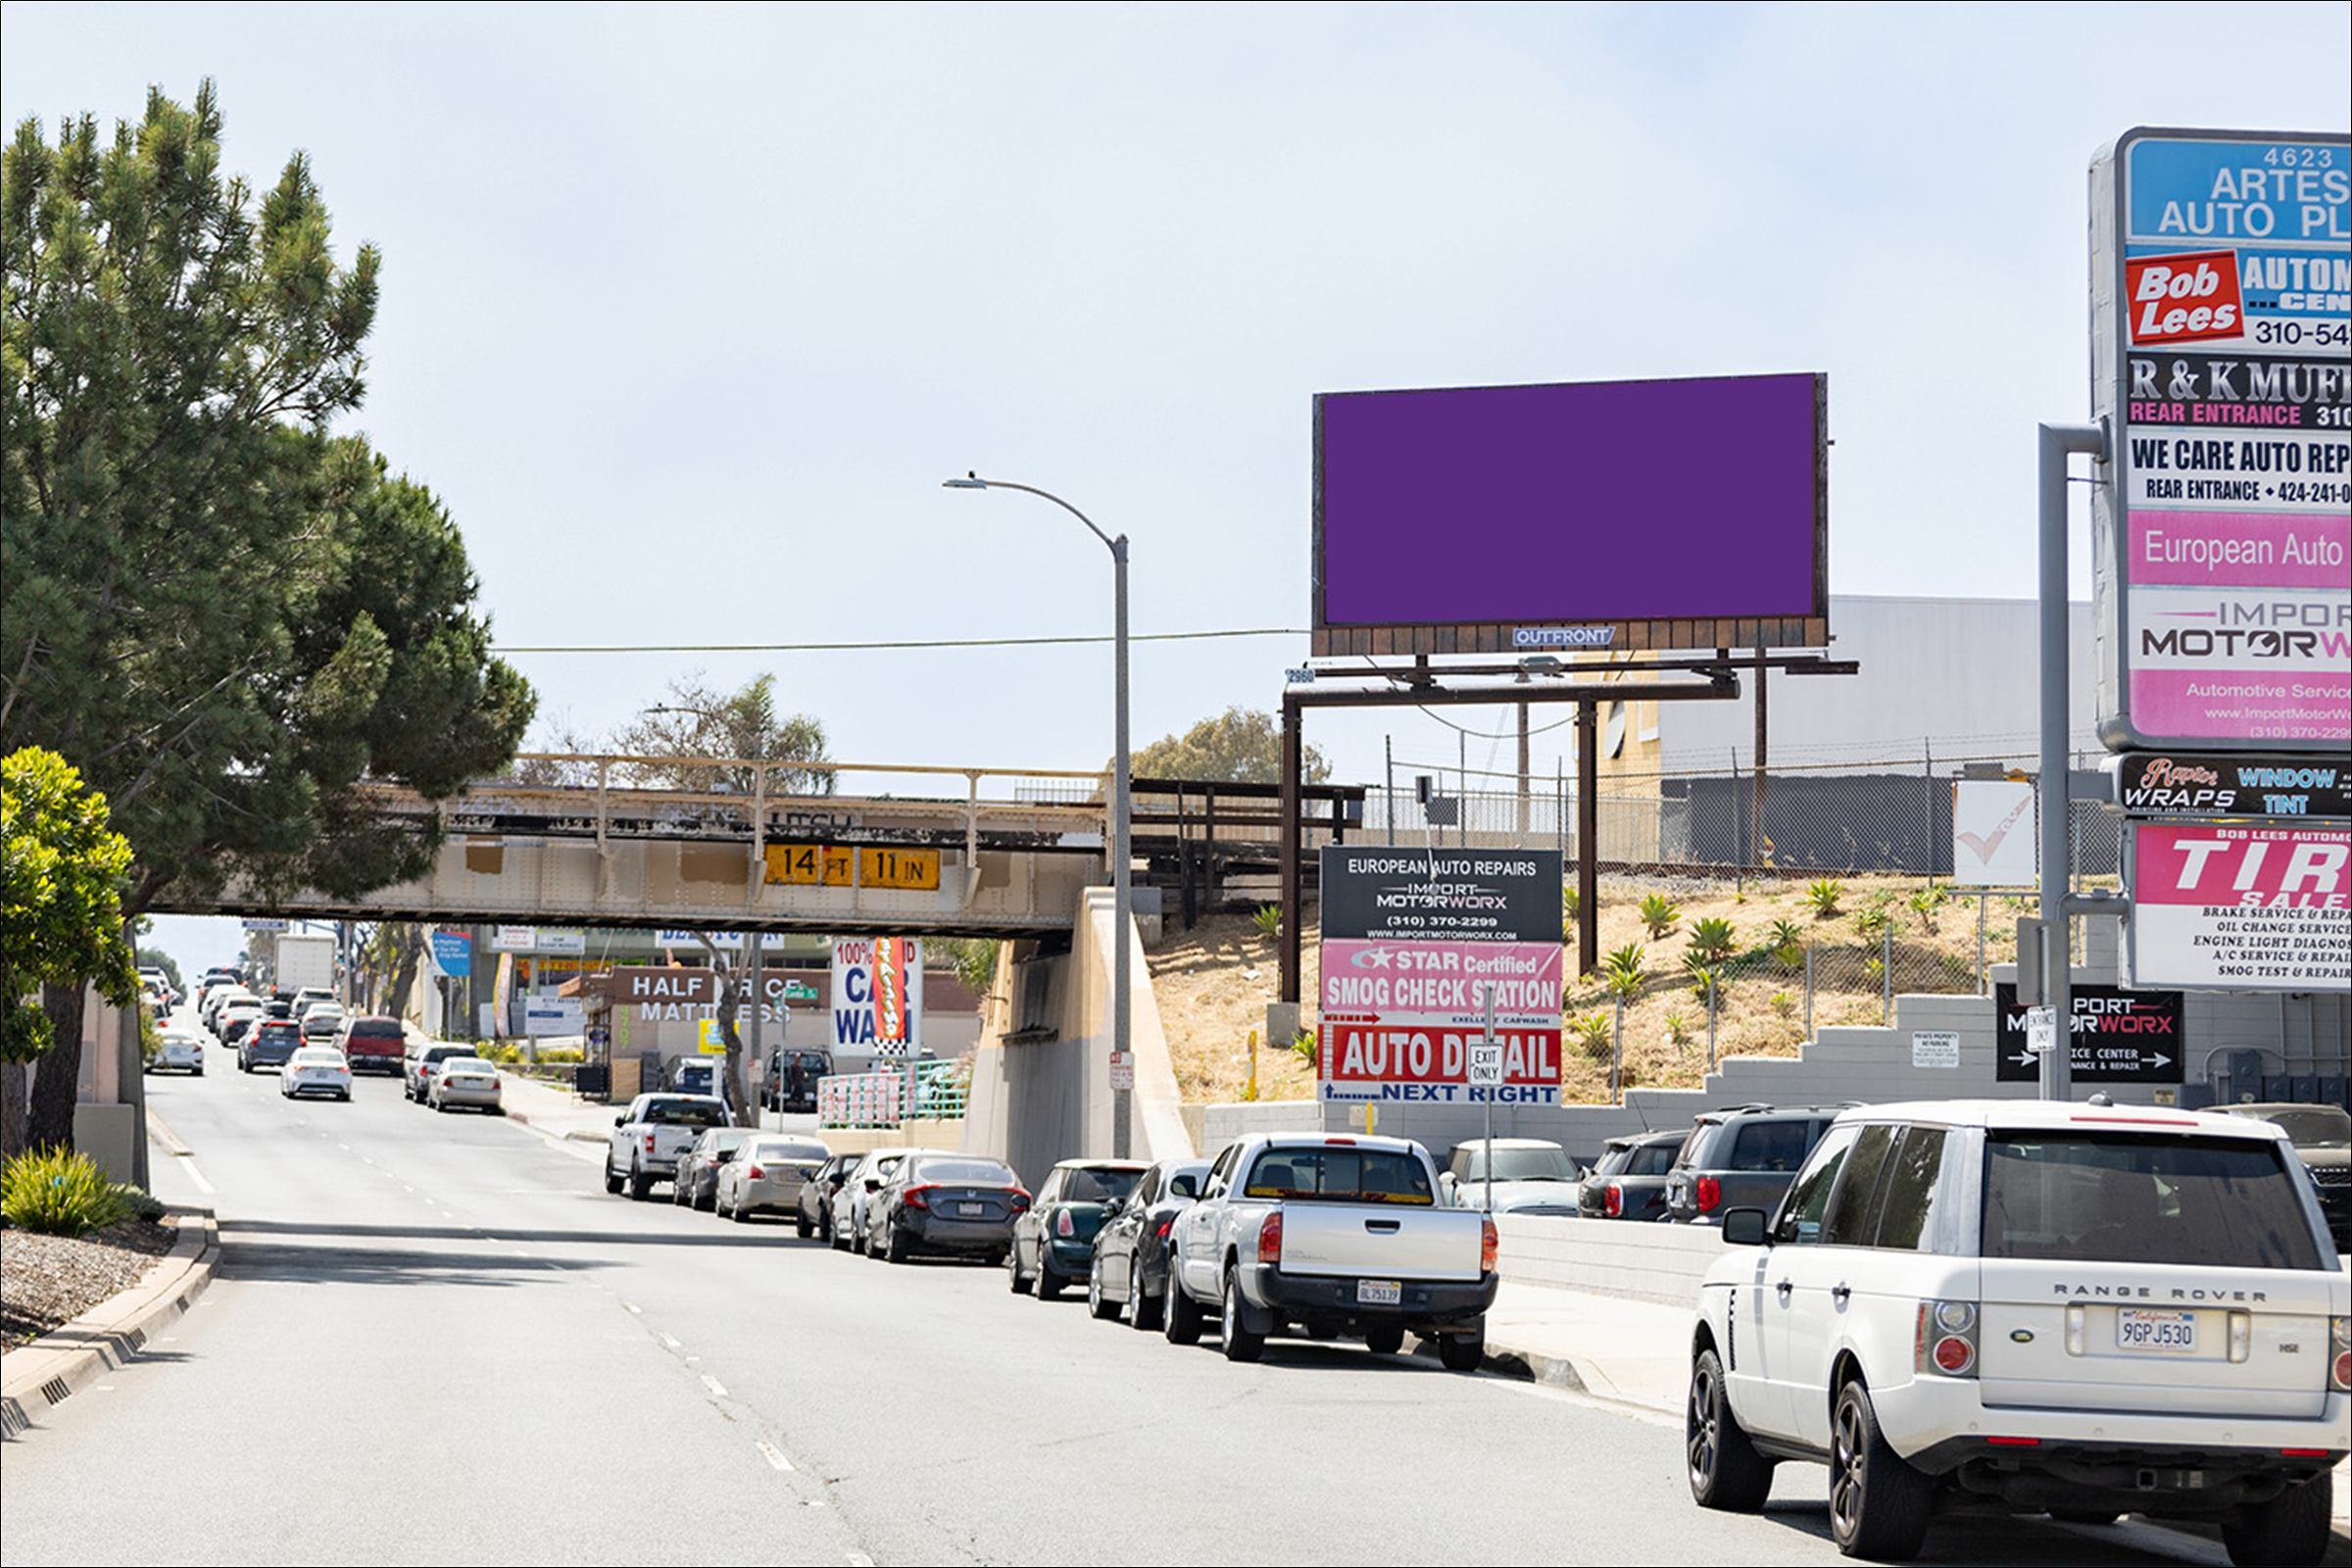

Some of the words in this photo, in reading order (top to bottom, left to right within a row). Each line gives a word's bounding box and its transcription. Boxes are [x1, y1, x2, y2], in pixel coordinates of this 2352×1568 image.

[2264, 147, 2332, 168] 4623
[2210, 168, 2350, 204] ARTES
[2158, 201, 2276, 237] AUTO
[2303, 206, 2350, 237] PL
[2135, 263, 2221, 301] Bob
[2137, 302, 2237, 335] Lees
[2256, 321, 2350, 345] 310-54
[2131, 359, 2162, 399] R
[2168, 359, 2199, 400] &
[2207, 362, 2240, 400] K
[2131, 402, 2185, 422] REAR
[2192, 403, 2301, 425] ENTRANCE
[2132, 439, 2169, 469] WE
[2175, 439, 2234, 470] CARE
[2239, 441, 2301, 472] AUTO
[2146, 478, 2182, 499] REAR
[2187, 480, 2260, 502] ENTRANCE
[2278, 482, 2350, 504] 424-241-0
[2145, 530, 2273, 570] European
[2281, 533, 2343, 565] Auto
[1517, 629, 1609, 643] OUTFRONT
[1289, 669, 1314, 683] 2960
[2186, 683, 2286, 698] Automotive
[2250, 727, 2286, 739] (310)
[2140, 759, 2219, 790] Raptor
[2237, 767, 2337, 789] WINDOW
[2125, 789, 2237, 808] WRAPS
[2263, 795, 2310, 814] TINT
[2217, 829, 2248, 839] BOB
[2252, 831, 2288, 841] LEES
[785, 849, 815, 876] 14
[825, 858, 849, 877] FT
[877, 852, 896, 879] 11
[905, 860, 924, 881] IN
[1348, 858, 1427, 874] EUROPEAN
[1432, 859, 1471, 876] AUTO
[1474, 860, 1537, 877] REPAIRS
[2173, 840, 2349, 893] TIR
[1408, 883, 1478, 896] IMORT
[1377, 895, 1507, 909] MOTORWORX
[2239, 892, 2348, 909] SALE
[1387, 916, 1425, 927] (310)
[1430, 916, 1498, 927] 370-2299
[2202, 906, 2247, 918] BRAKE
[2250, 907, 2304, 919] SERVICE
[2308, 909, 2318, 919] &
[2217, 921, 2238, 932] OIL
[2241, 922, 2295, 933] CHANGE
[2298, 924, 2350, 934] SERVICE
[2193, 935, 2245, 947] ENGINE
[2249, 937, 2289, 948] LIGHT
[837, 942, 873, 964] 100%
[1396, 951, 1458, 970] STAR
[1463, 955, 1537, 974] Certified
[2213, 950, 2236, 961] A/C
[2240, 951, 2294, 961] SERVICE
[2298, 952, 2308, 961] &
[2218, 965, 2254, 976] SMOG
[2258, 966, 2289, 977] TEST
[2292, 967, 2302, 977] &
[2305, 967, 2350, 978] REPAIR
[633, 976, 704, 997] HALF
[1328, 977, 1390, 1005] SMOG
[1395, 977, 1467, 1007] CHECK
[641, 1002, 792, 1023] MATTESS
[1342, 1031, 1432, 1076] AUTO
[1443, 1033, 1556, 1078] DAIL
[1475, 1050, 1496, 1064] EXIT
[2096, 1048, 2139, 1059] CENTER
[1473, 1066, 1498, 1080] ONLY
[1382, 1083, 1458, 1101] NEXT
[1469, 1085, 1557, 1103] RIGHT
[2054, 1284, 2151, 1298] RANGE
[2172, 1289, 2267, 1301] ROVER
[2124, 1322, 2192, 1345] 9GPJ530
[2279, 1344, 2299, 1353] HSE
